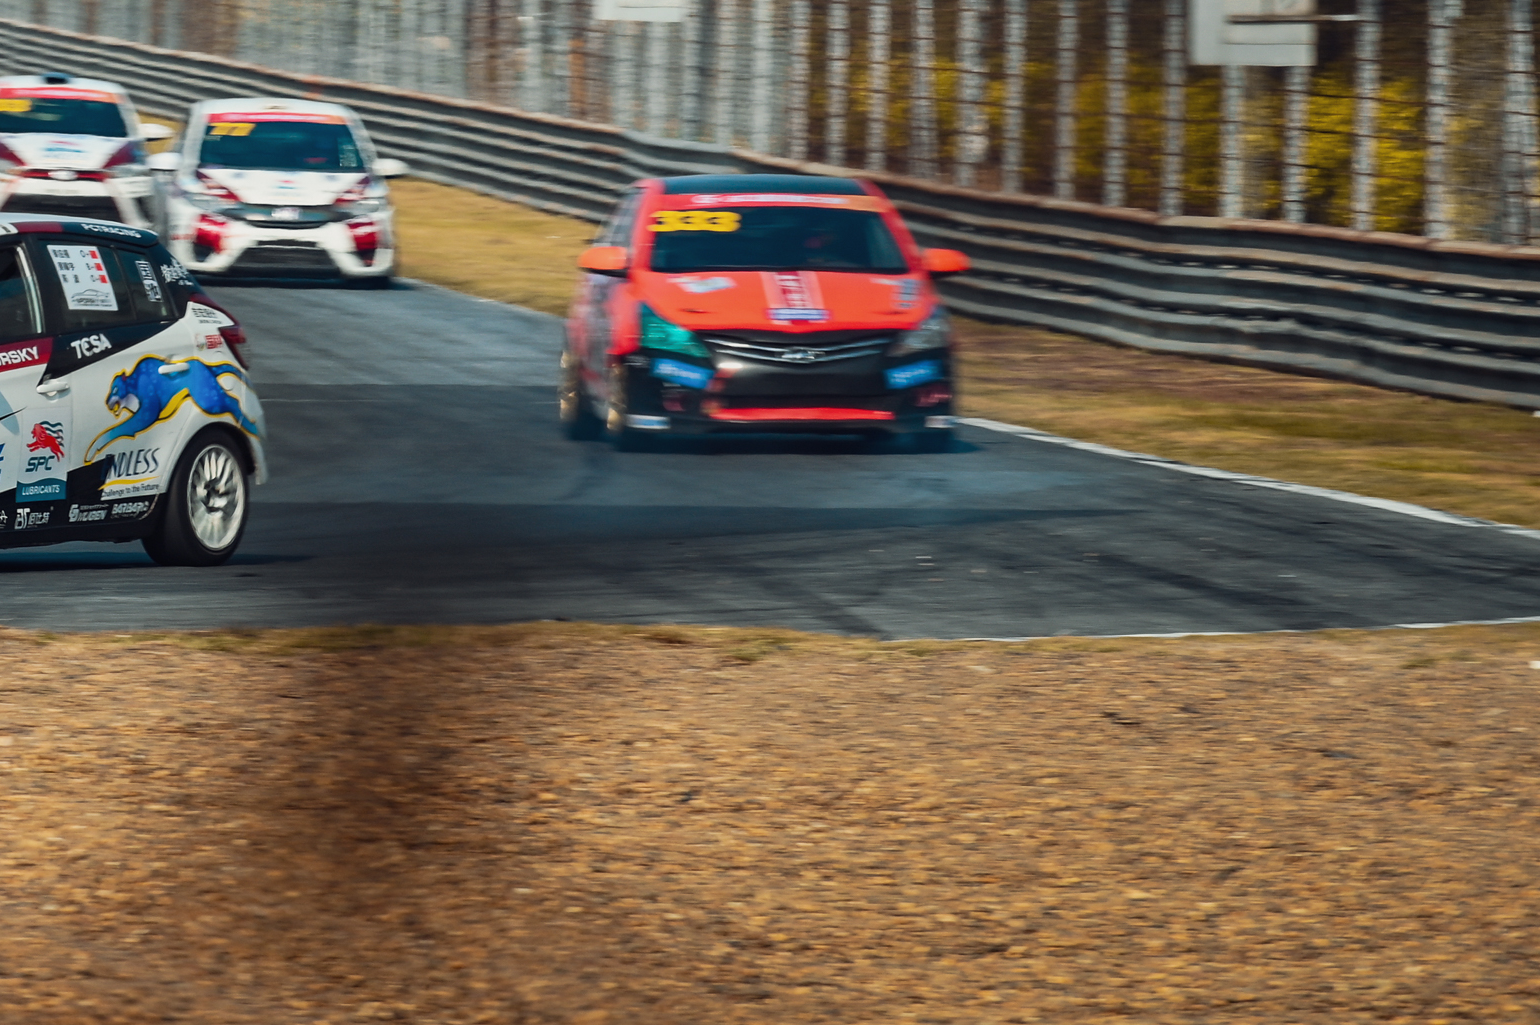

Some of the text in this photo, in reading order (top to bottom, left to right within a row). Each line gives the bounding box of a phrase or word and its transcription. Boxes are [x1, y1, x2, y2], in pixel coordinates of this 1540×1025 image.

[648, 211, 742, 232] 333
[25, 455, 55, 473] SPC
[21, 484, 61, 496] LUBRICANTS
